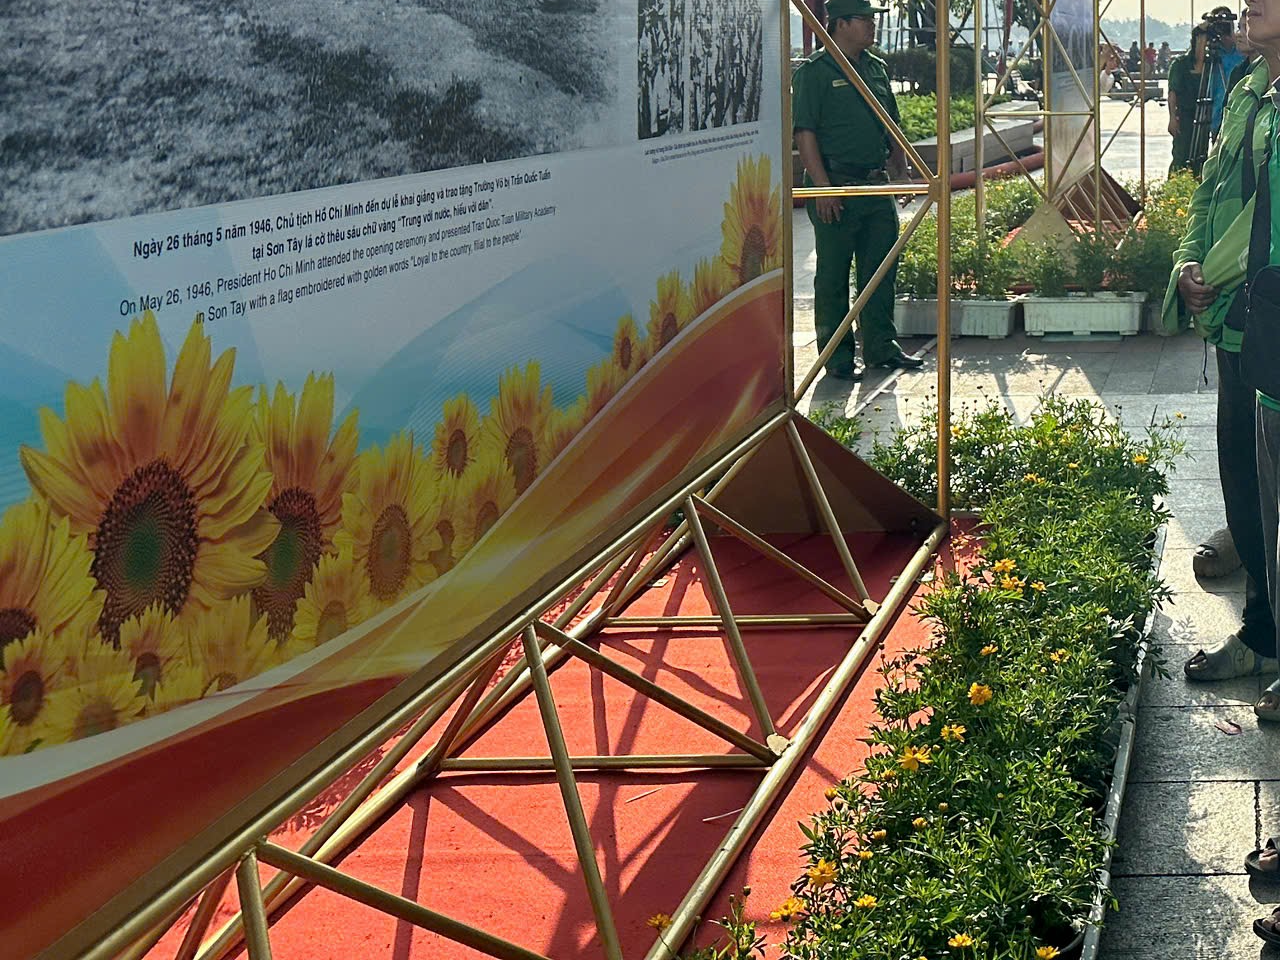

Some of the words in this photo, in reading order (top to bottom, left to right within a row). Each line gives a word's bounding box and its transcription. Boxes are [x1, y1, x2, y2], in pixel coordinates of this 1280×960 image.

[133, 238, 163, 259] Ngày
[166, 235, 180, 251] 26
[182, 230, 213, 247] tháng
[215, 227, 222, 242] 5
[225, 224, 246, 240] năm
[250, 218, 273, 236] 1946,
[276, 213, 294, 230] Chủ
[296, 212, 312, 229] tịch
[344, 202, 363, 217] Minh
[365, 198, 379, 214] đến
[381, 197, 391, 212] dự
[400, 192, 415, 207] khai
[416, 189, 435, 206] giảng
[445, 187, 458, 197] trao
[252, 244, 264, 261] tại
[266, 242, 284, 257] Sơn
[315, 232, 326, 246] cờ
[327, 229, 345, 243] thêu
[378, 219, 396, 233] vàng
[120, 299, 136, 316] On
[140, 294, 163, 312] May
[166, 288, 183, 305] 26,
[187, 281, 214, 300] 1946,
[217, 272, 261, 293] President
[264, 267, 276, 282] Ho
[278, 263, 293, 279] Chi
[295, 258, 315, 275] Minh
[317, 249, 350, 270] attended
[352, 247, 364, 260] the
[366, 242, 394, 259] opening
[394, 233, 427, 250] ceremony
[428, 229, 440, 241] and
[441, 221, 471, 242] presented
[472, 220, 485, 232] Tran
[195, 310, 205, 325] in
[208, 305, 227, 321] Son
[230, 301, 247, 316] Tay
[249, 293, 267, 310] with
[269, 293, 276, 305] a
[277, 288, 293, 304] flag
[295, 275, 345, 299] embroidered
[347, 271, 362, 285] with
[363, 265, 388, 284] golden
[389, 258, 409, 273] words
[431, 251, 438, 262] to
[439, 249, 449, 260] the
